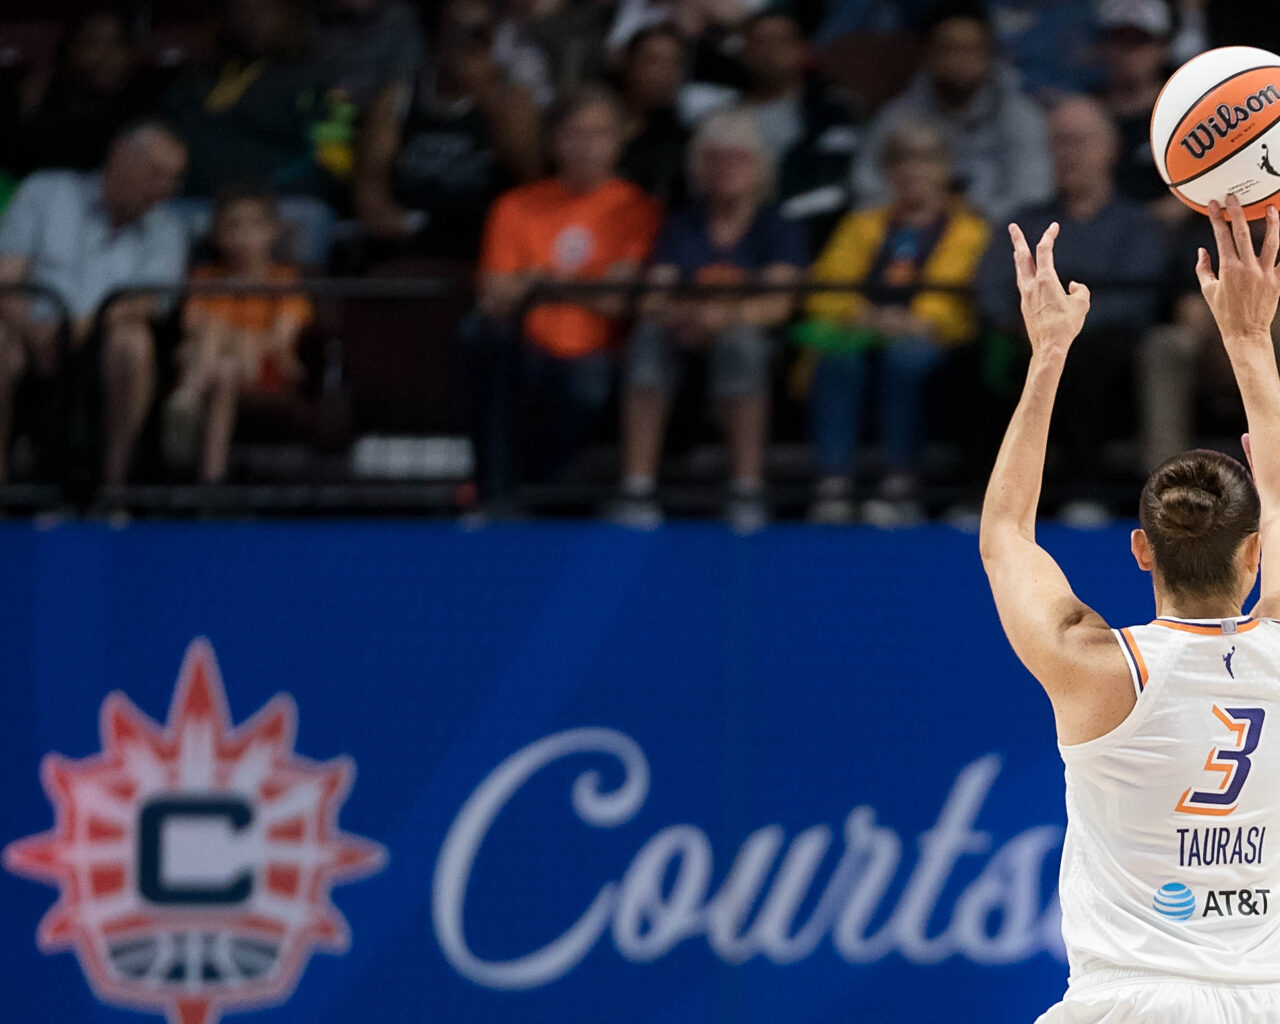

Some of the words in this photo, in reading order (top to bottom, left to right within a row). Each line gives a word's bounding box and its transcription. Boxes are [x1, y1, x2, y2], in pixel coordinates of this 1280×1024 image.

[1174, 704, 1265, 816] 3
[135, 796, 256, 907] C
[432, 726, 1066, 989] Courts
[1176, 826, 1266, 867] TAURASI
[1202, 889, 1271, 917] AT&T
